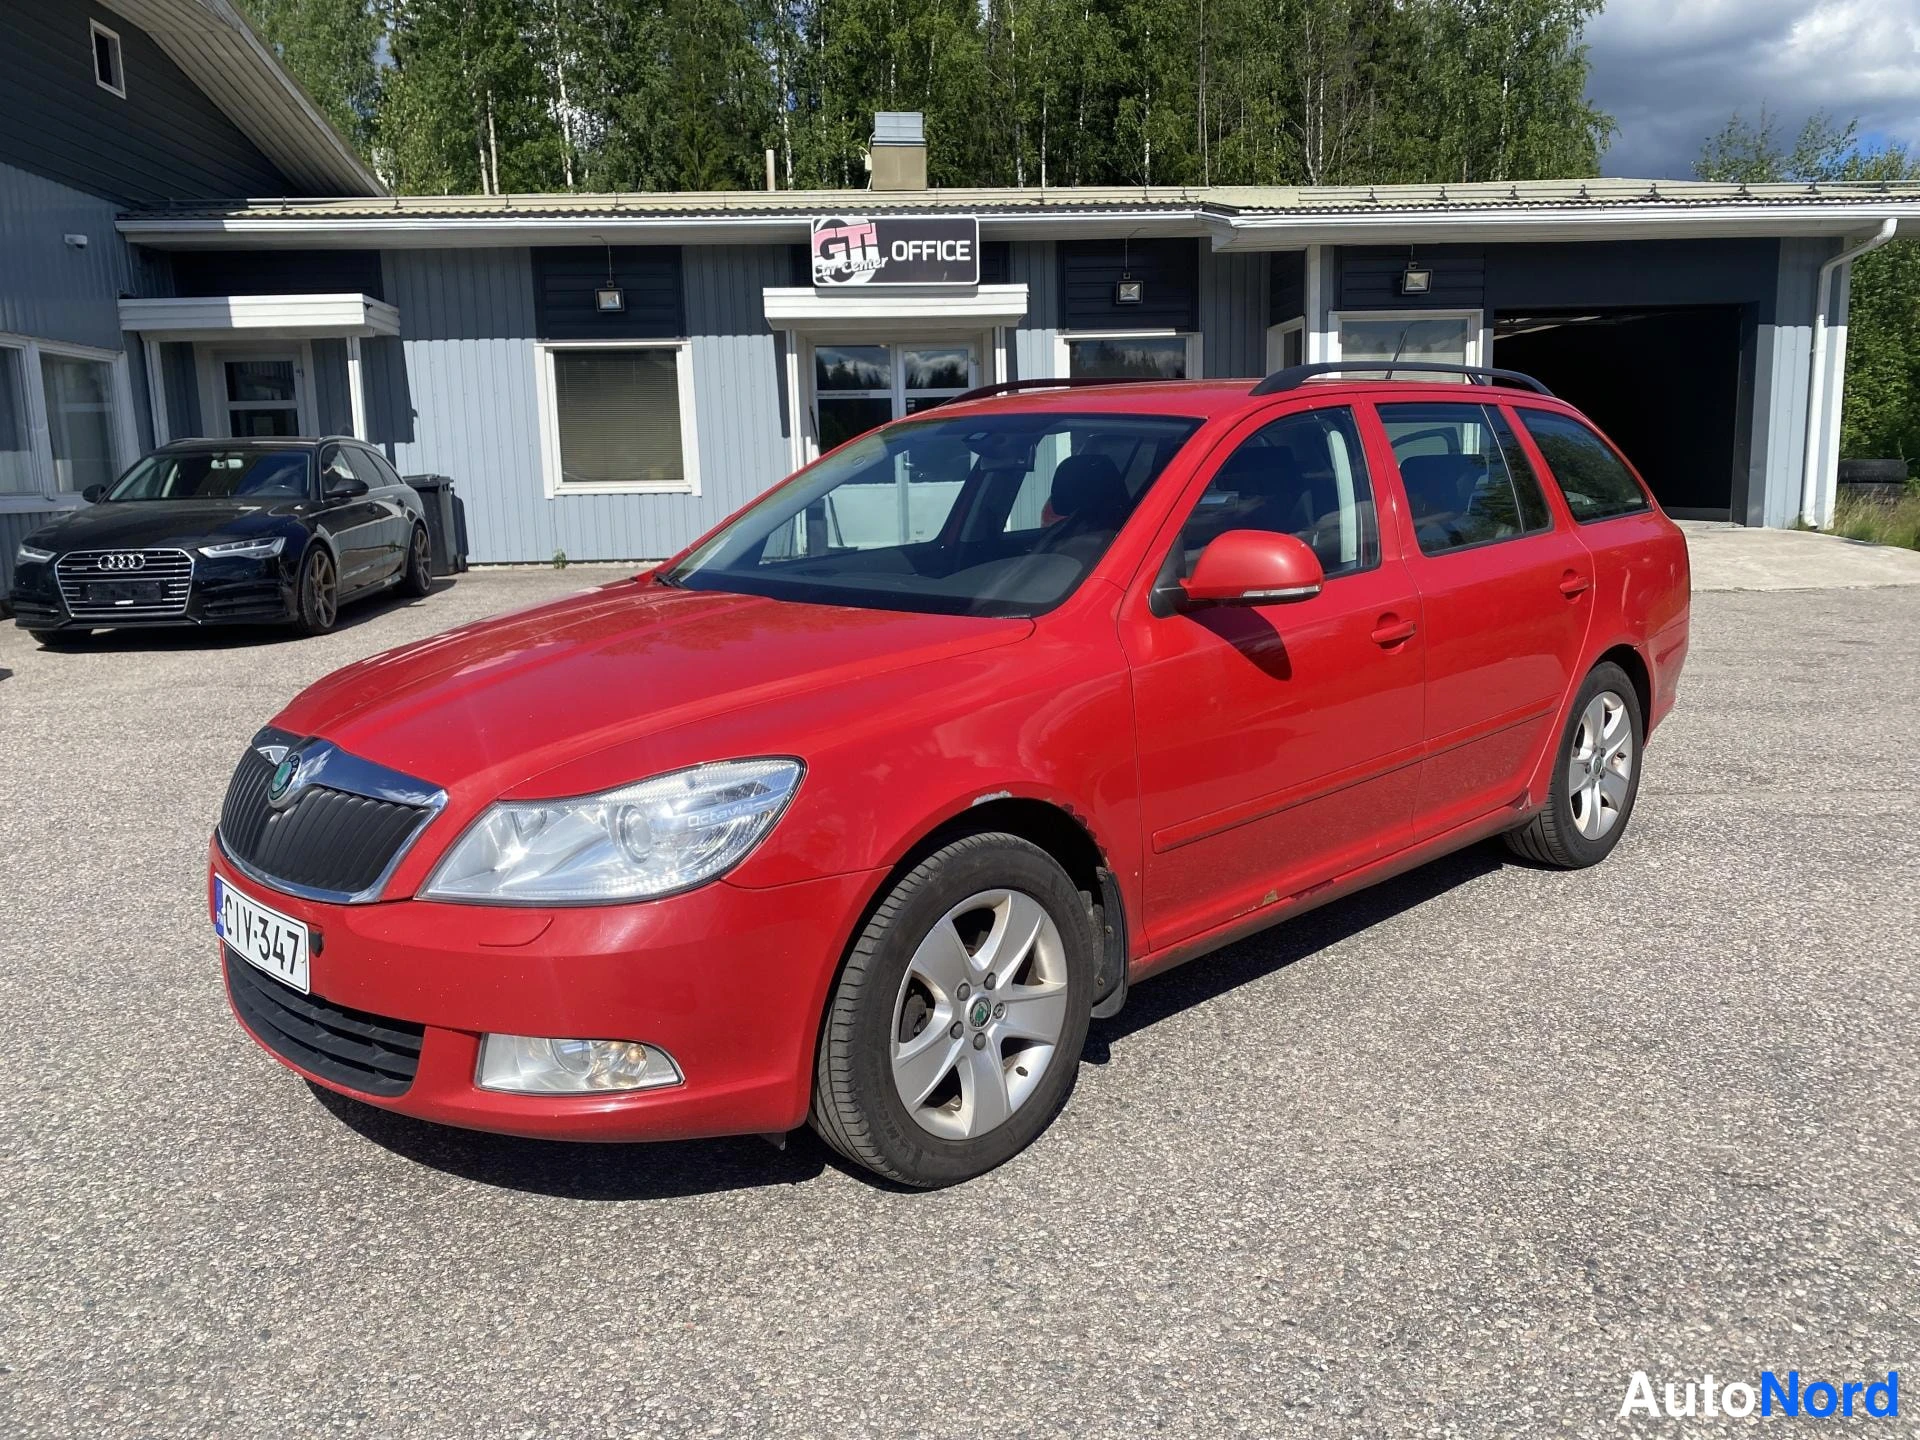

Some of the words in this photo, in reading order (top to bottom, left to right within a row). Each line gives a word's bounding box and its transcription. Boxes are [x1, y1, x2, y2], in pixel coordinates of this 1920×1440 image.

[891, 240, 971, 261] OFFICE
[841, 256, 888, 274] Center
[688, 803, 753, 827] Octavia
[225, 894, 299, 975] CIV-347
